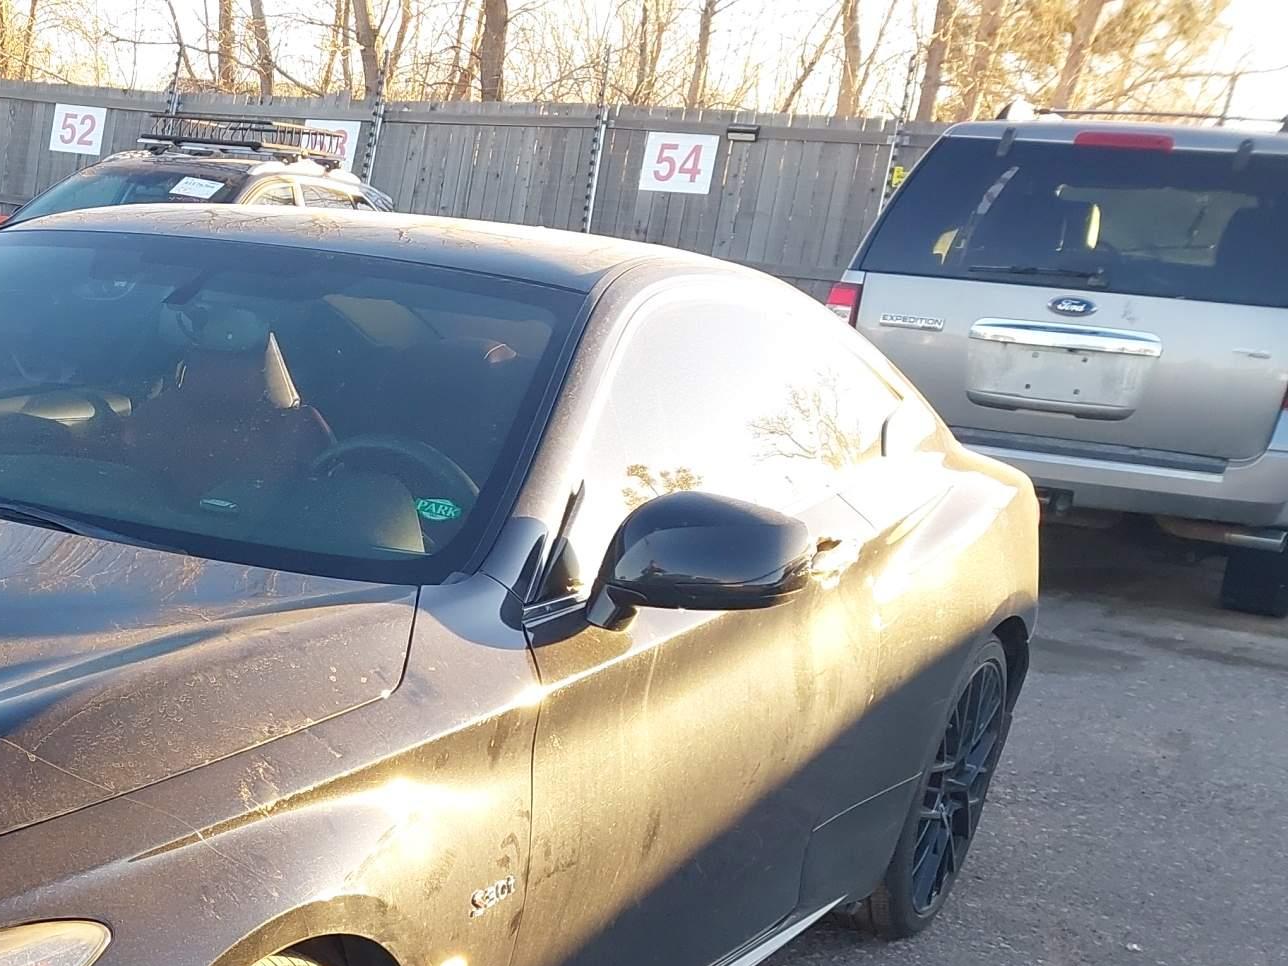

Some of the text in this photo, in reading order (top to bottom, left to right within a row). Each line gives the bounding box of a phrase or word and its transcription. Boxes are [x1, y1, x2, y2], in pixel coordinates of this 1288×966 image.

[59, 112, 97, 146] 52
[653, 143, 704, 183] 54
[1056, 299, 1087, 312] Ford
[881, 313, 943, 327] EXPEDITION
[417, 500, 456, 518] PARK
